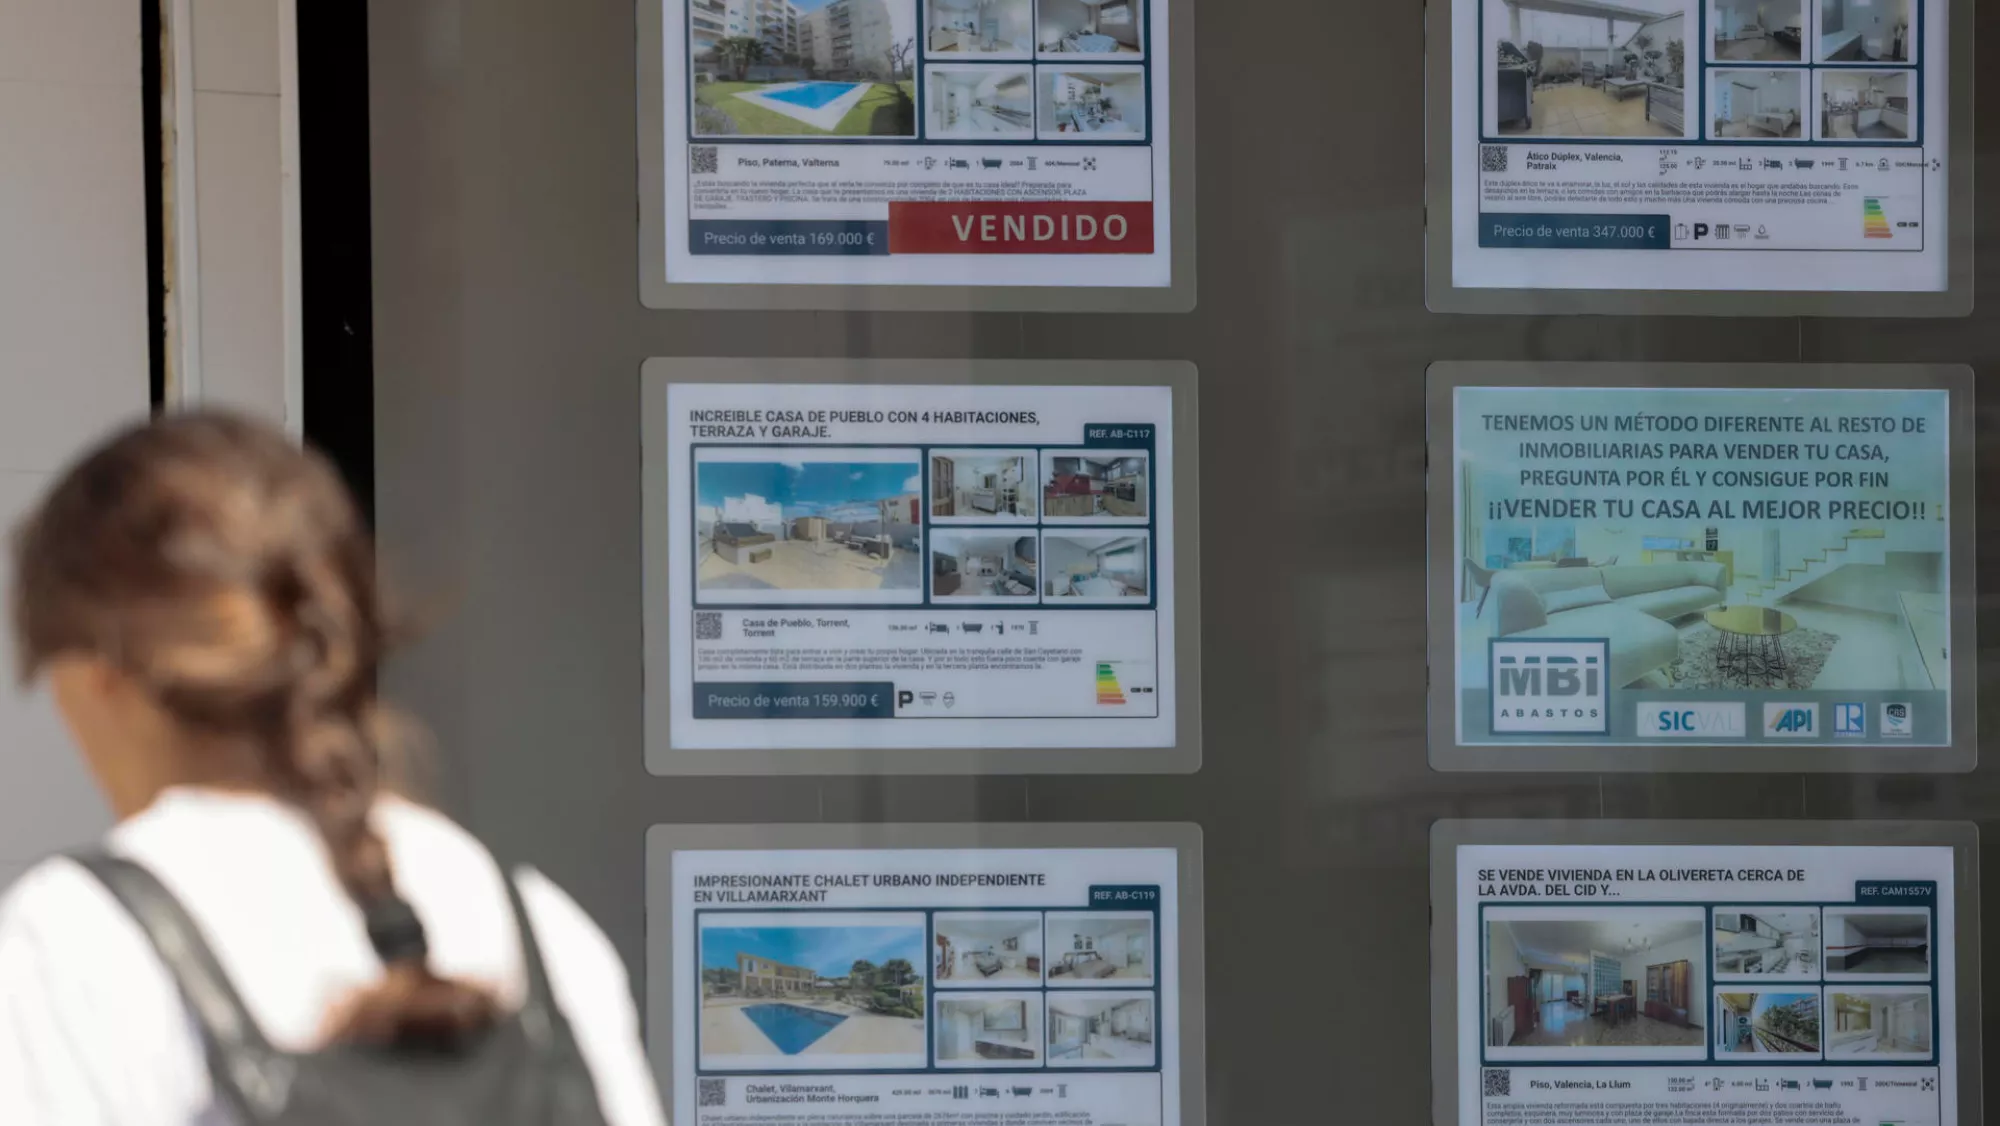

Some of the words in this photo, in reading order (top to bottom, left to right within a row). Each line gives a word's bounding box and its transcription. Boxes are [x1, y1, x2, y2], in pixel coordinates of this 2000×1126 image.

[738, 158, 761, 168] Piso,
[762, 158, 800, 168] Paterna,
[802, 158, 840, 167] Valterna
[1526, 152, 1549, 162] Ático
[1552, 152, 1582, 163] Dúplex,
[1584, 153, 1623, 163] Valencia,
[1527, 162, 1556, 170] Patraix
[952, 214, 1128, 242] VENDIDO
[1494, 224, 1533, 238] Precio
[1536, 225, 1552, 238] de
[1557, 226, 1589, 238] venta
[1593, 226, 1644, 238] 347.000
[1648, 226, 1655, 238] €
[704, 232, 746, 245] Precio
[750, 232, 766, 245] de
[769, 233, 805, 245] venta
[810, 232, 862, 245] 169.000
[867, 233, 875, 245] €
[690, 410, 761, 422] INCREIBLE
[766, 410, 804, 422] CASA
[808, 410, 825, 422] DE
[830, 410, 883, 423] PUEBLO
[888, 411, 918, 423] CON
[922, 412, 930, 423] 4
[934, 412, 1040, 426] HABITACIONES,
[1482, 414, 1574, 431] TENEMOS
[1580, 415, 1608, 431] UN
[1614, 411, 1698, 432] MÉTODO
[1704, 416, 1804, 432] DIFERENTE
[1810, 416, 1832, 433] AL
[1838, 417, 1896, 433] RESTO
[1902, 418, 1926, 433] DE
[691, 426, 754, 438] TERRAZA
[760, 426, 768, 438] Y
[772, 426, 832, 438] GARAJE.
[1090, 429, 1108, 438] REF.
[1110, 429, 1150, 439] AB-C117
[1519, 442, 1663, 458] INMOBILIARIAS
[1670, 444, 1718, 459] PARA
[1724, 444, 1798, 460] VENDER
[1804, 444, 1829, 460] TU
[1836, 444, 1889, 463] CASA,
[1520, 470, 1620, 486] PREGUNTA
[1626, 470, 1664, 486] POR
[1671, 466, 1690, 486] ÉL
[1696, 470, 1706, 486] Y
[1712, 470, 1808, 488] CONSIGUE
[1816, 472, 1853, 488] POR
[1860, 472, 1888, 488] FIN
[1489, 499, 1597, 520] ¡¡VENDER
[1604, 500, 1634, 518] TU
[1642, 500, 1700, 518] CASA
[1708, 500, 1736, 519] AL
[1742, 500, 1820, 520] MEJOR
[1829, 500, 1926, 520] PRECIO!!
[742, 618, 765, 628] Casa
[767, 618, 778, 628] de
[780, 618, 815, 629] Pueblo,
[818, 618, 850, 629] Torrent,
[744, 629, 775, 637] Torrent
[708, 694, 749, 707] Precio
[753, 694, 770, 707] de
[774, 695, 809, 707] venta
[813, 694, 866, 707] 159.900
[870, 694, 879, 707] €
[1500, 708, 1598, 718] ABASTOS
[1775, 708, 1812, 732] API
[694, 875, 810, 888] IMPRESIONANTE
[814, 875, 870, 887] CHALET
[873, 874, 932, 886] URBANO
[936, 874, 1046, 886] INDEPENDIENTE
[1478, 870, 1495, 881] SE
[1498, 870, 1544, 881] VENDE
[1548, 870, 1610, 881] VIVIENDA
[1616, 870, 1634, 881] EN
[1638, 870, 1656, 881] LA
[1660, 870, 1734, 882] OLIVERETA
[1738, 870, 1782, 882] CERCA
[1788, 870, 1804, 882] DE
[694, 890, 712, 902] EN
[716, 890, 828, 902] VILLAMARXANT
[1094, 891, 1113, 900] REF.
[1116, 891, 1155, 900] AB-C119
[1478, 884, 1496, 896] LA
[1500, 884, 1541, 896] AVDA.
[1546, 884, 1570, 896] DEL
[1574, 884, 1596, 896] CID
[1600, 884, 1620, 896] Y...
[1860, 887, 1879, 896] REF.
[1882, 887, 1932, 896] CAM1557V
[746, 1084, 777, 1094] Chalet,
[1530, 1080, 1552, 1090] Piso,
[1554, 1080, 1594, 1090] Valencia,
[1596, 1080, 1607, 1089] La
[1609, 1080, 1631, 1090] Llum
[746, 1094, 804, 1104] Urbanización
[807, 1094, 834, 1102] Monte
[838, 1094, 879, 1104] Horquera
